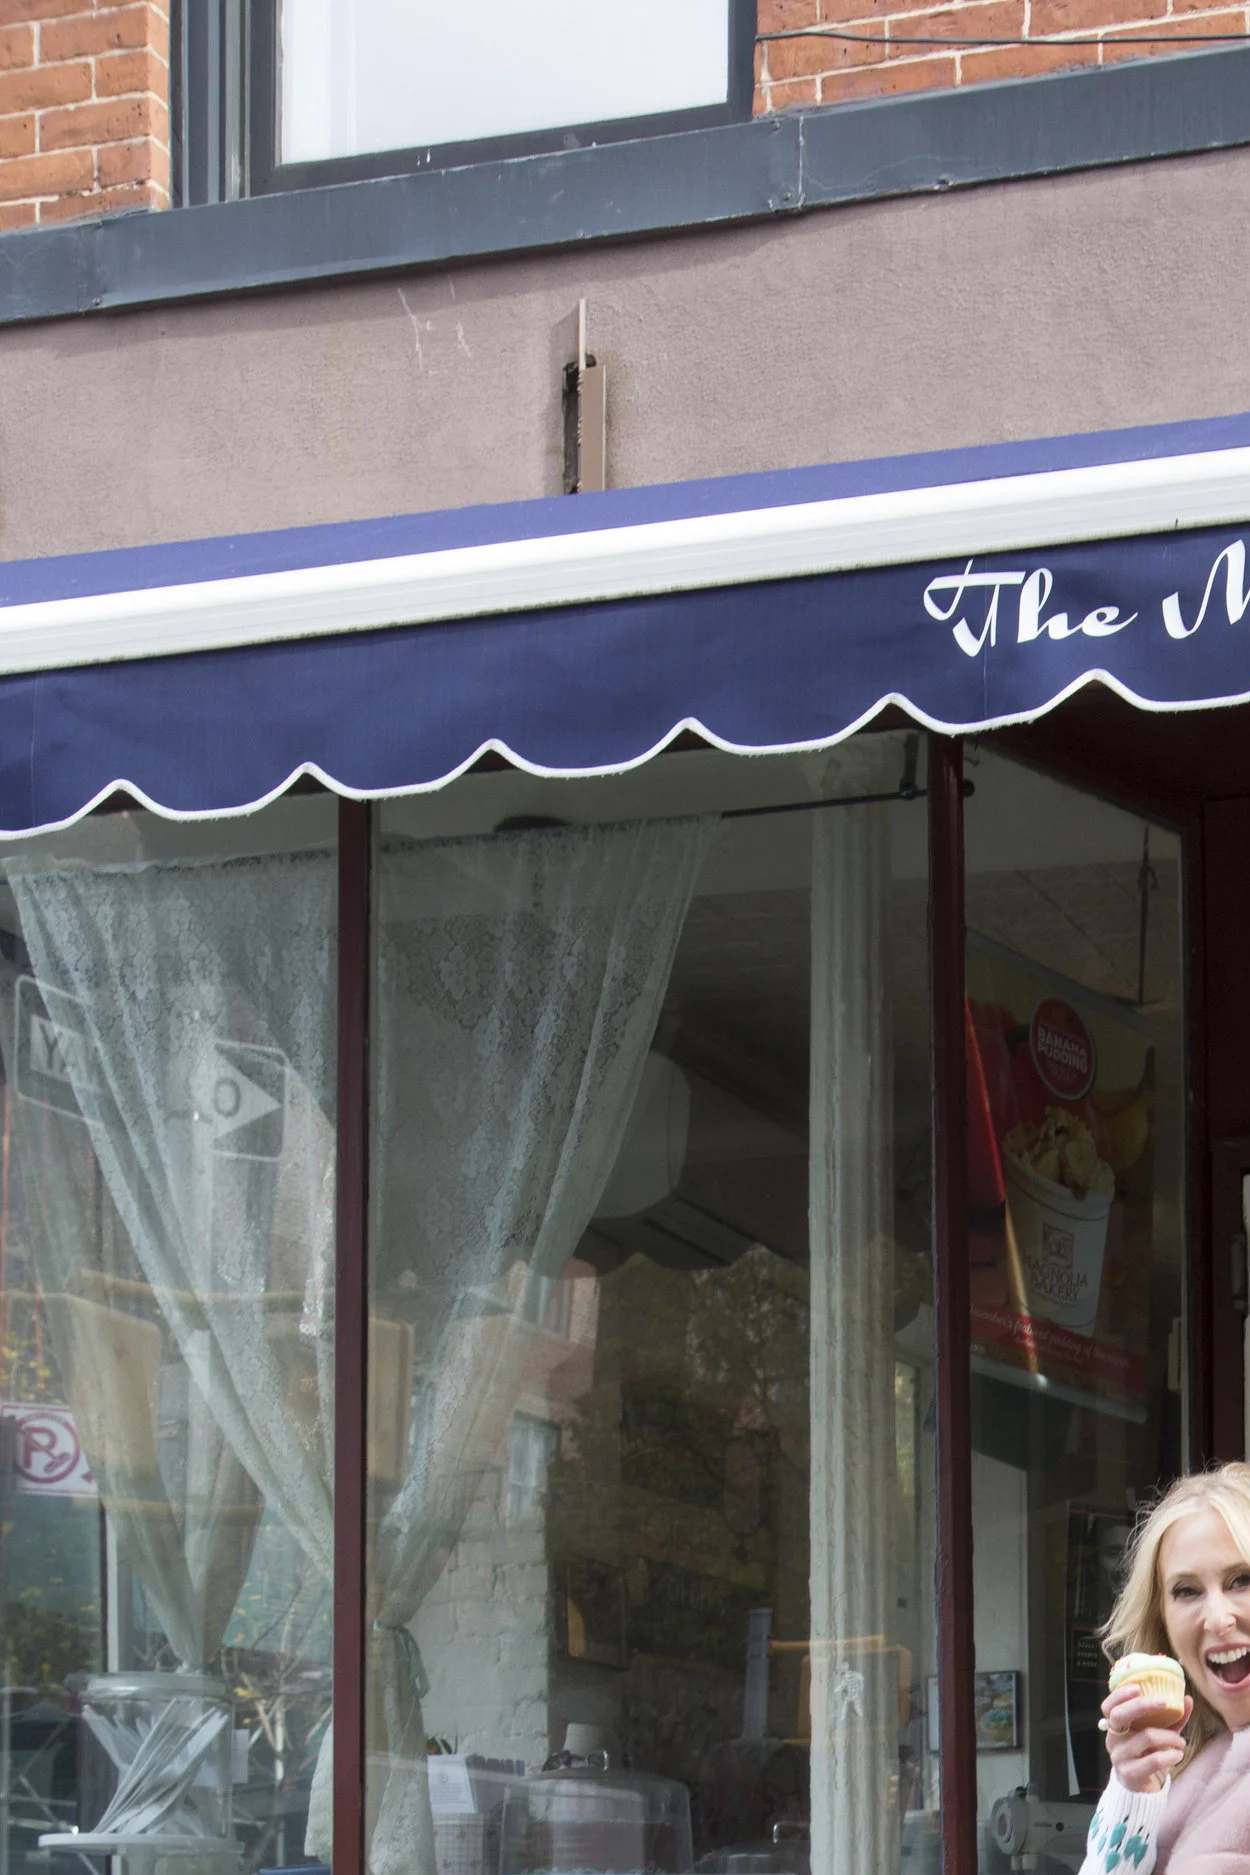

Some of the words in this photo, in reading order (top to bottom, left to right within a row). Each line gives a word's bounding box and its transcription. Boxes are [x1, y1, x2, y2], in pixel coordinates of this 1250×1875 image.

[922, 556, 1139, 659] The
[1037, 1026, 1088, 1055] BANANA
[1037, 1039, 1088, 1074] PUDDING
